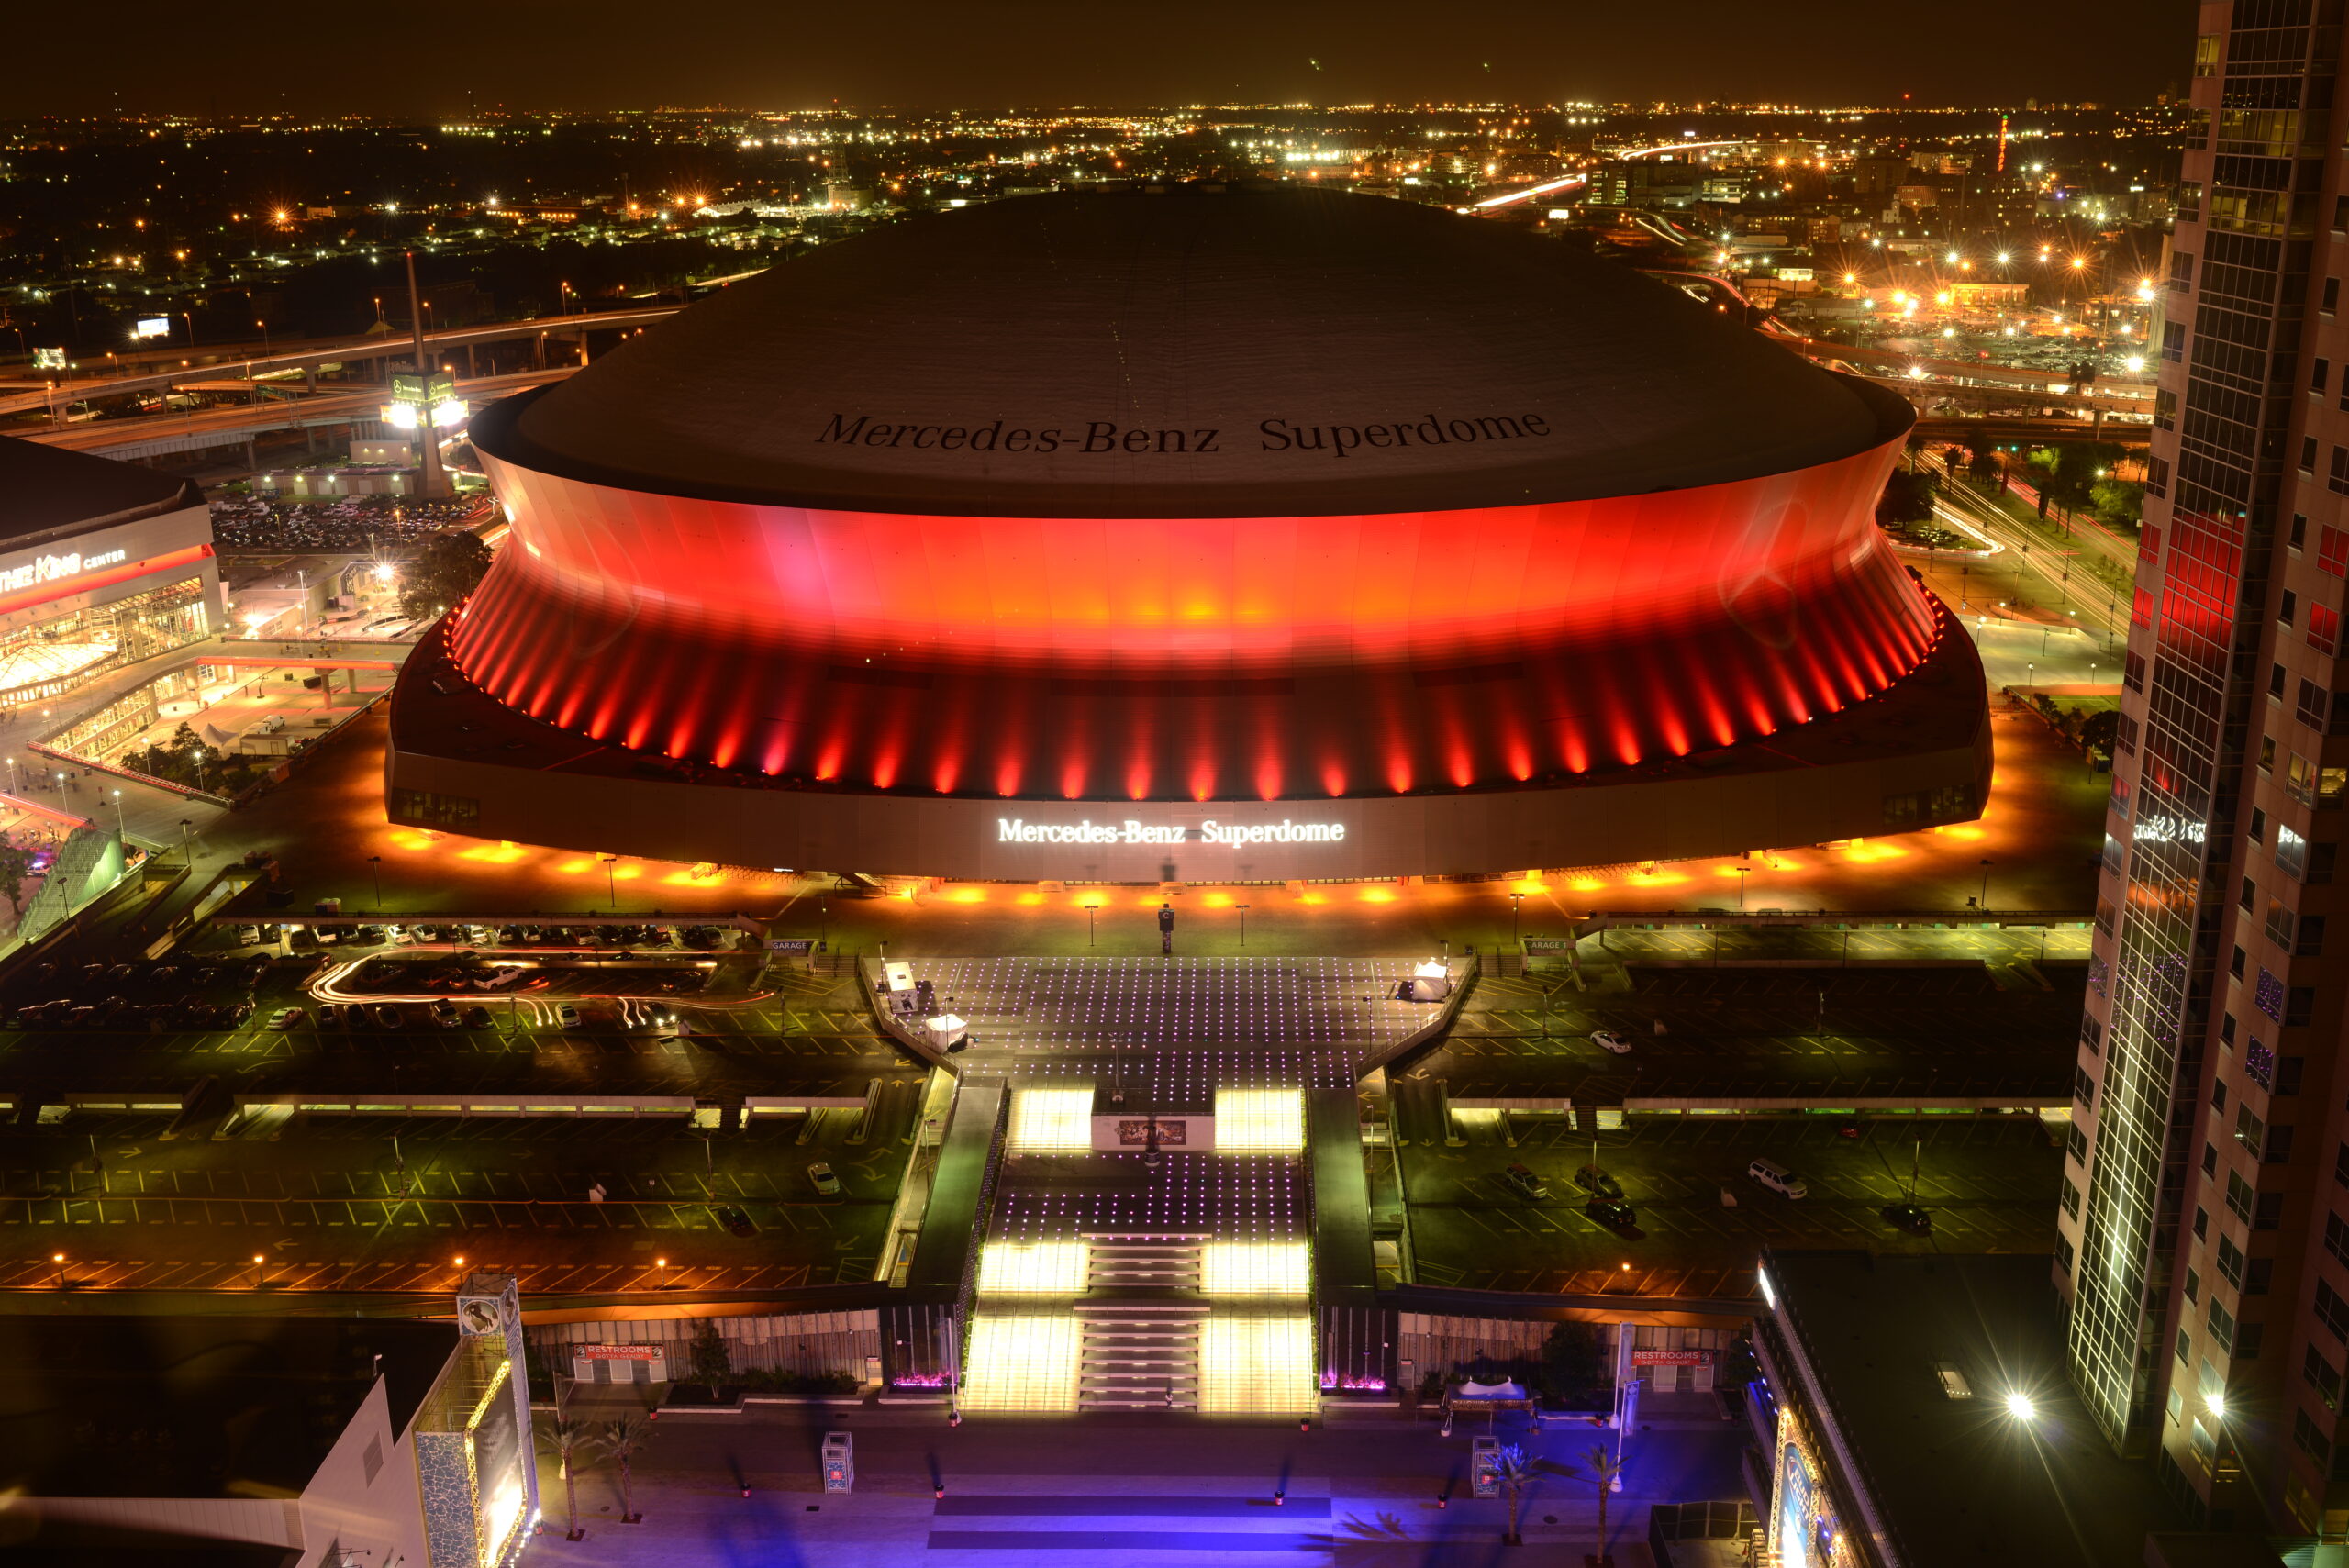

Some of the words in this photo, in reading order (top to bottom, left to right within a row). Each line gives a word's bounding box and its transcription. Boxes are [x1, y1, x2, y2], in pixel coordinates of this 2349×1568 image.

[815, 412, 1220, 453] Mercedes-Benz
[1259, 413, 1551, 458] Superdome
[83, 550, 126, 570] CENTER
[997, 819, 1186, 843] Mercedes-Benz
[1201, 819, 1345, 848] Superdome
[1526, 941, 1560, 950] GARAGE
[588, 1346, 651, 1354] RESTROOMS
[1634, 1351, 1698, 1360] RESTROOMS
[1794, 1467, 1809, 1507] BUD
